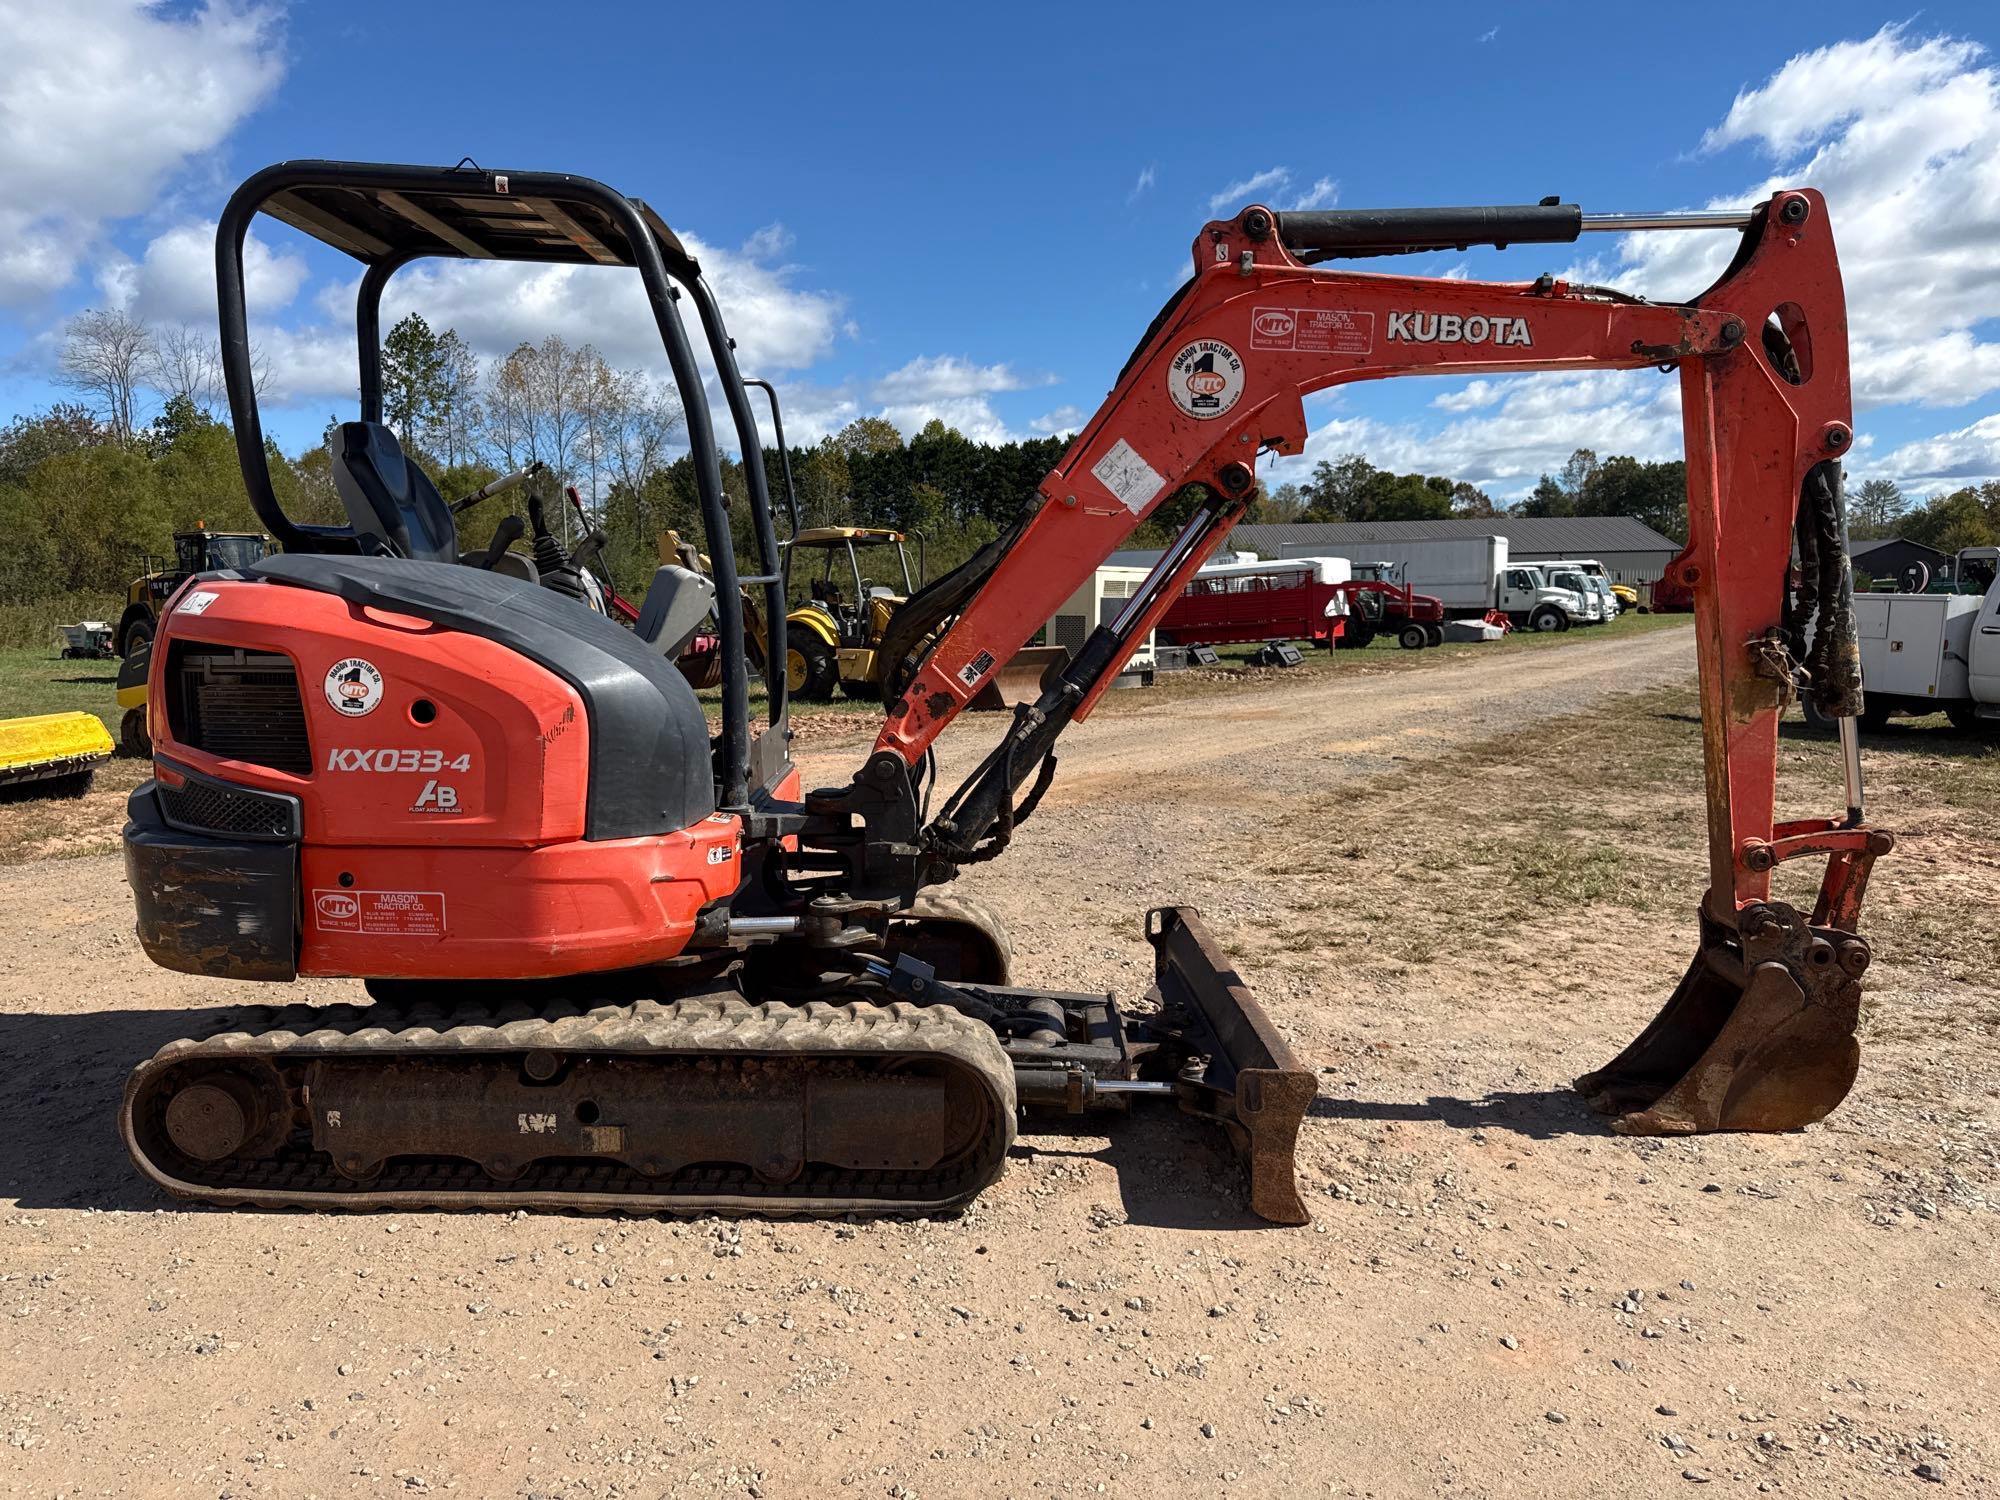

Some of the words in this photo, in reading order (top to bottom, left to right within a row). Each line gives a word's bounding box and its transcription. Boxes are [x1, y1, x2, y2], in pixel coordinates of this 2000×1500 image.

[1316, 313, 1351, 322] MASON
[1309, 320, 1343, 330] TRACTOR
[1387, 312, 1532, 346] KUBOTA
[1173, 345, 1197, 371] MASON
[1199, 342, 1232, 361] TRACTOR
[1229, 358, 1240, 374] CO.
[329, 661, 348, 679] MASON
[349, 660, 375, 675] TRACTOR
[327, 748, 471, 773] KX033-4
[380, 894, 419, 903] MASON
[372, 902, 411, 911] TRACTOR
